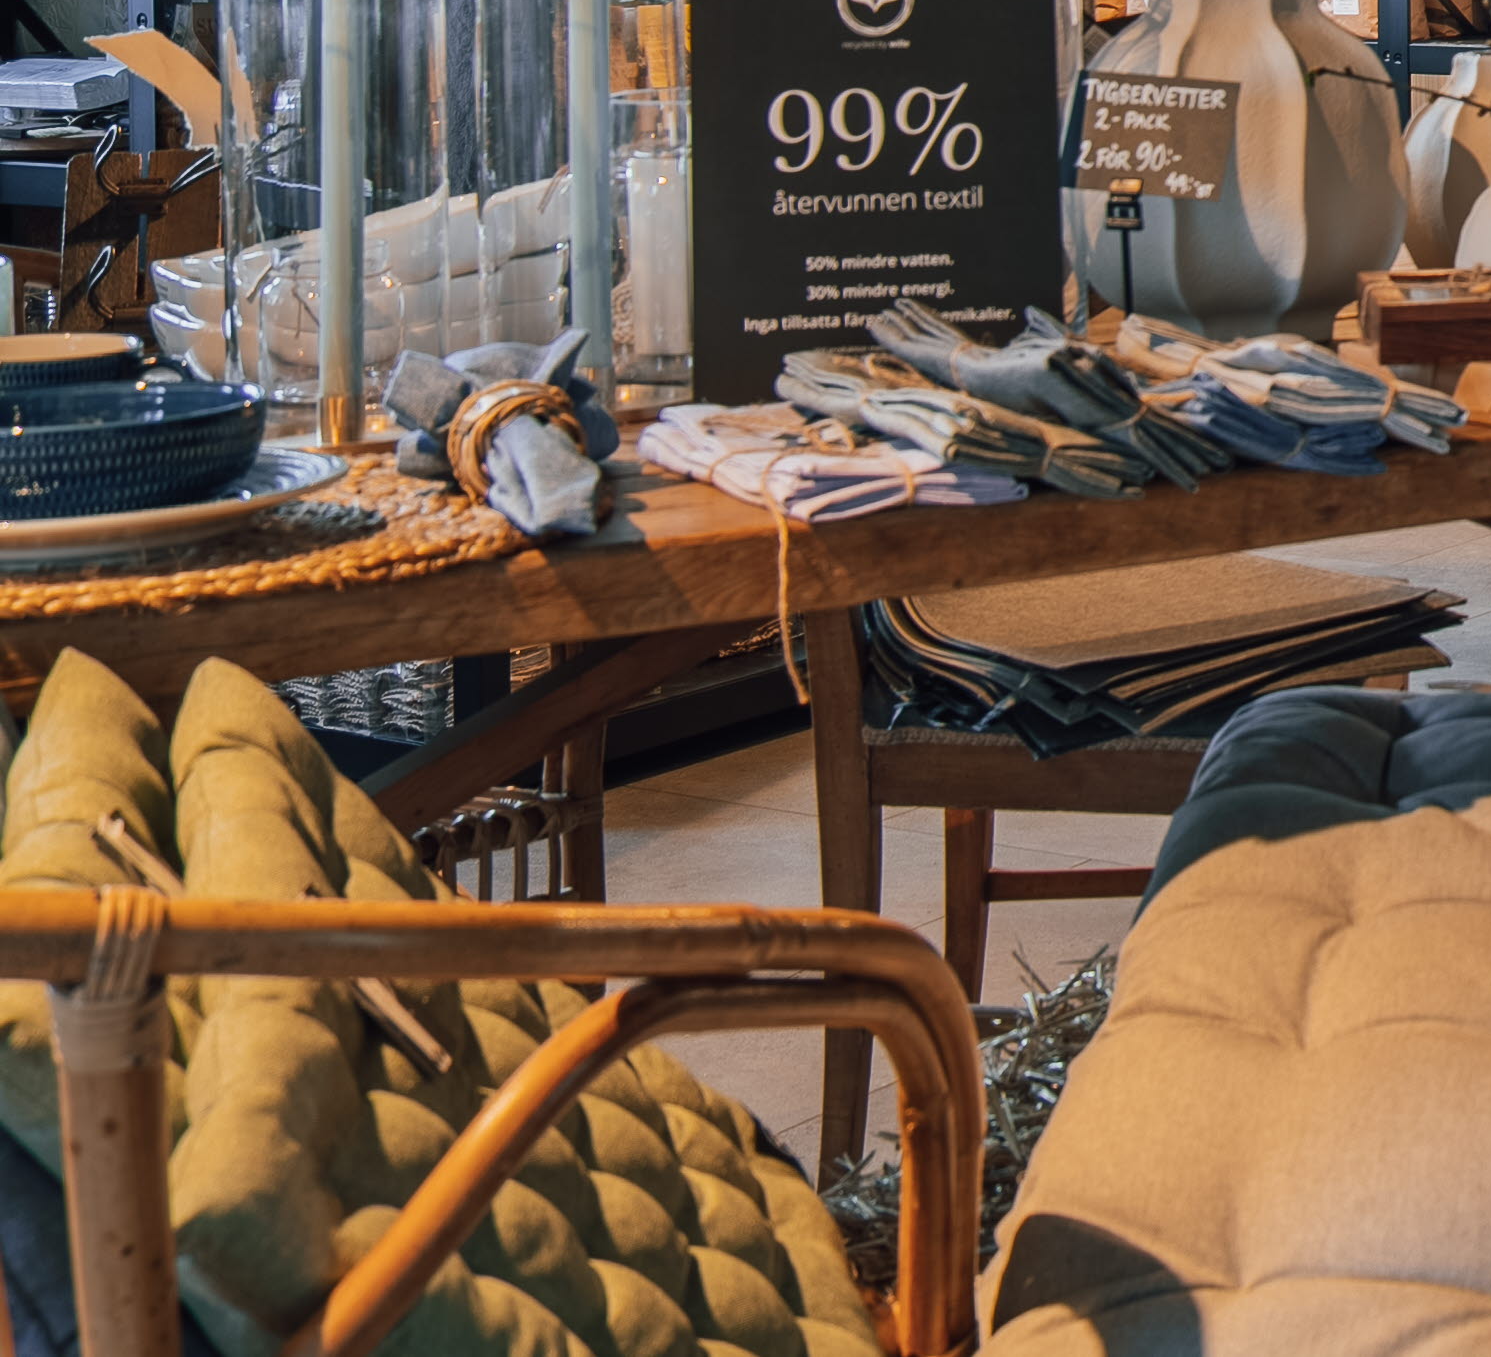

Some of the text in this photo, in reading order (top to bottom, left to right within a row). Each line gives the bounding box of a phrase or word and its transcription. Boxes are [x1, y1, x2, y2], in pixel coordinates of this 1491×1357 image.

[1082, 78, 1227, 110] TYGSERVETTER
[767, 82, 983, 176] 99%
[1075, 139, 1095, 170] 2
[1095, 143, 1131, 171] FÖR
[773, 185, 984, 216] återvunnen textil
[806, 253, 956, 272] 50% mindre vatten.
[807, 280, 955, 301] 30% mindre energi.
[744, 315, 841, 335] Inga tillsatta
